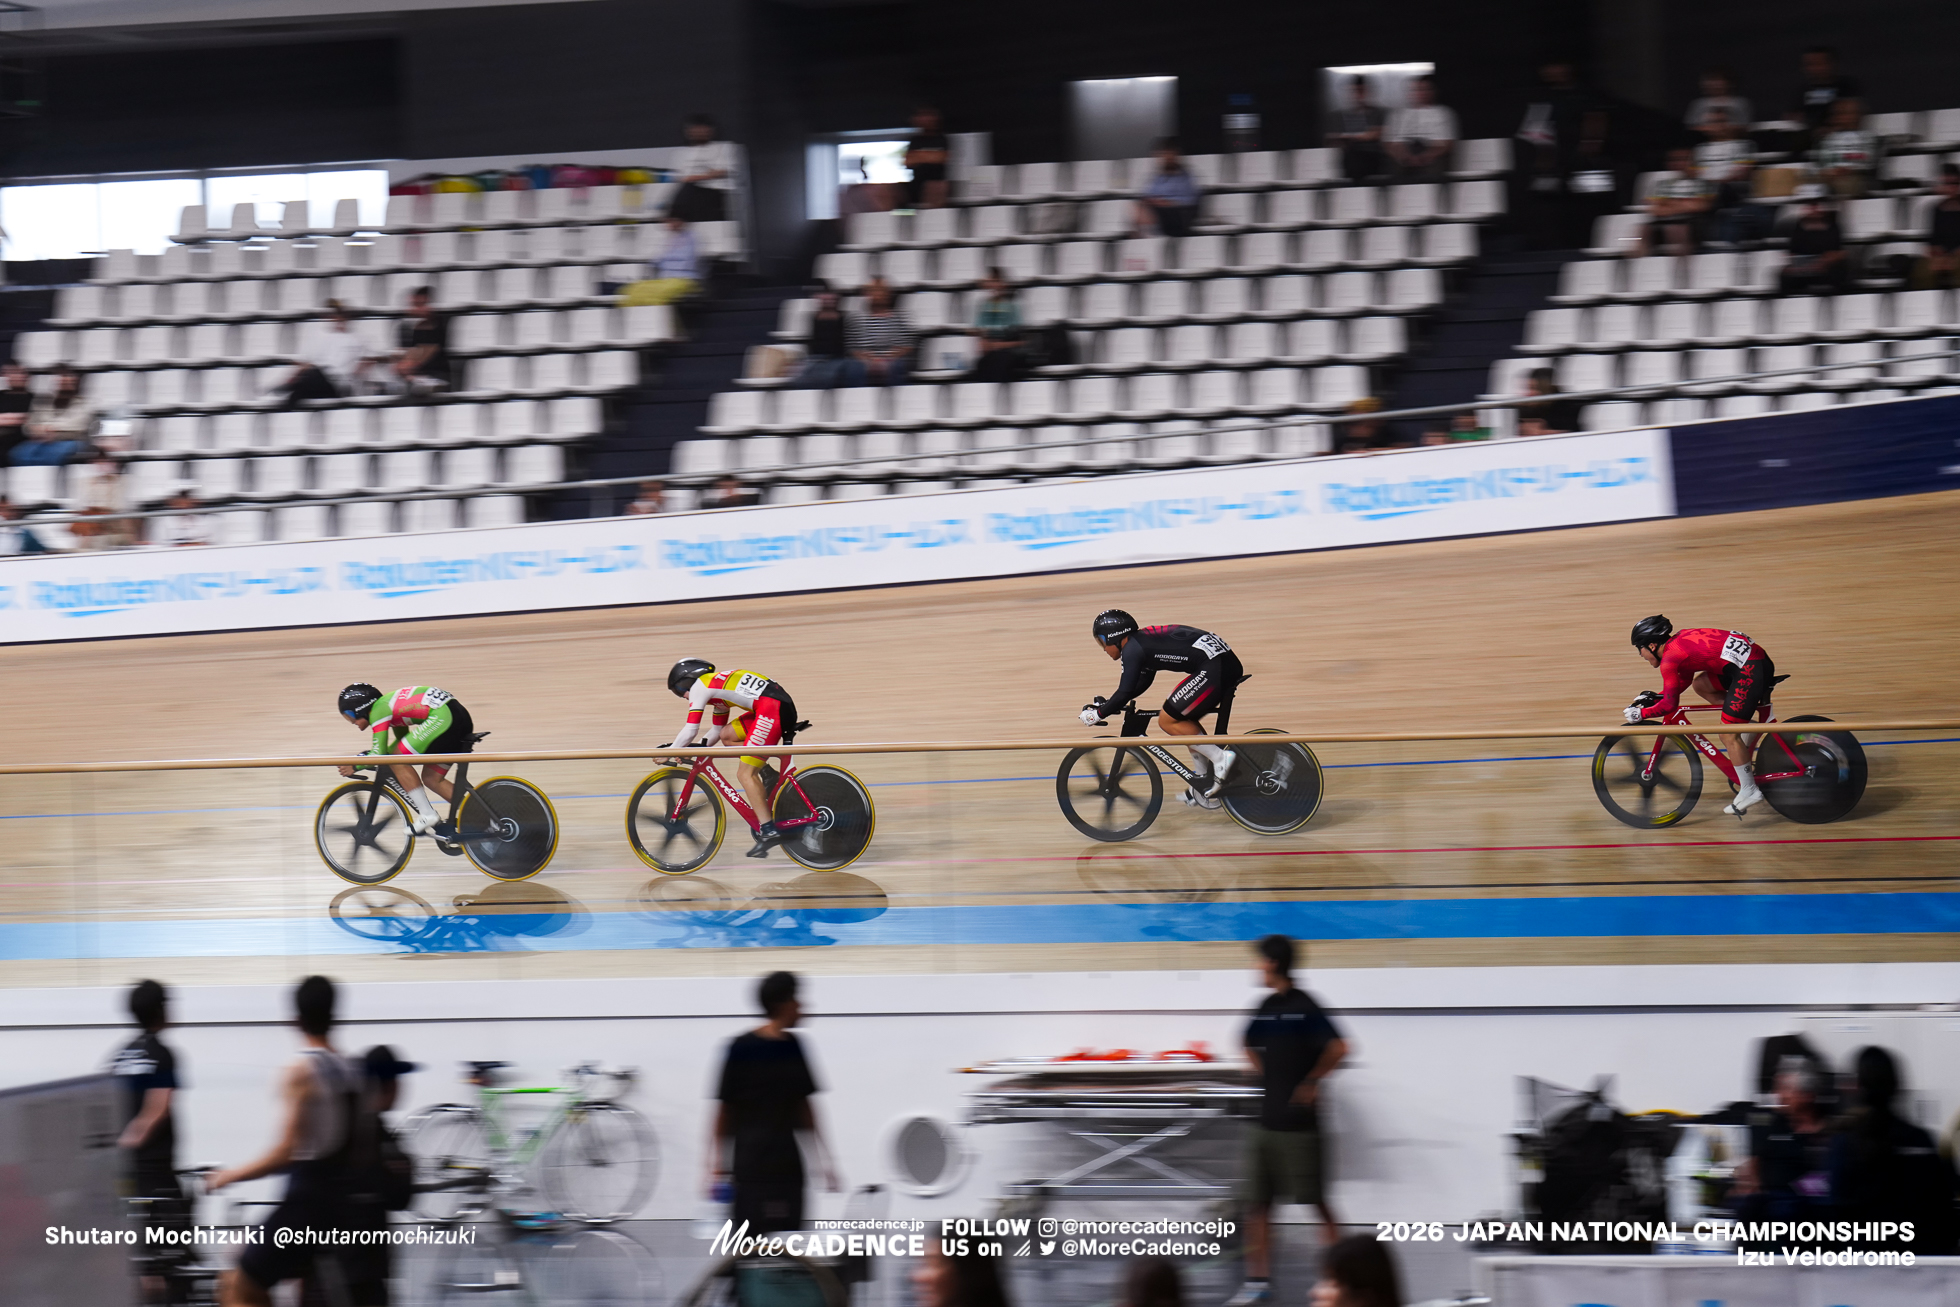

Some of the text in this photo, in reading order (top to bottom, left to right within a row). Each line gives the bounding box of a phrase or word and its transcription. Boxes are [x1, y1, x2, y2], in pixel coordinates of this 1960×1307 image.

[1200, 634, 1223, 653] 324
[1725, 637, 1751, 656] 327
[740, 674, 766, 691] 319
[1147, 744, 1194, 781] IDGESTONE
